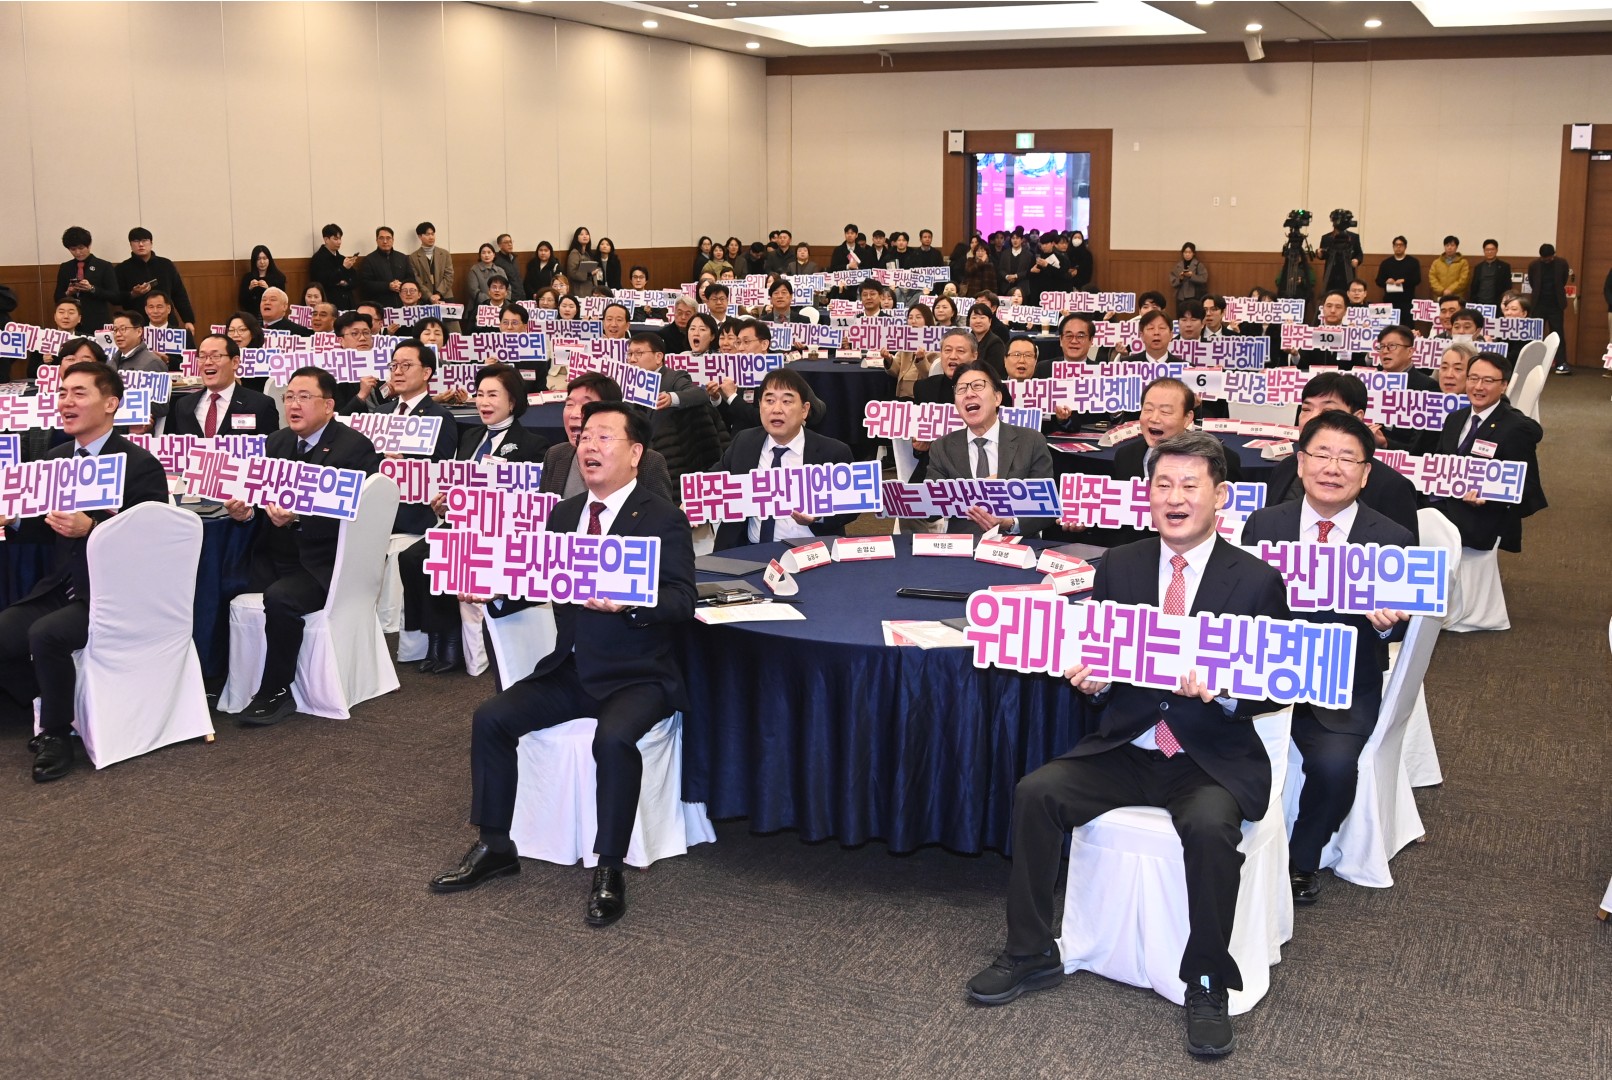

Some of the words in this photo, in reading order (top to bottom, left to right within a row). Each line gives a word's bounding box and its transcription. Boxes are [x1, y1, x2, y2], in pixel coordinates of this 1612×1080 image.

[667, 292, 677, 300] 16
[1040, 291, 1066, 311] 우리가
[1069, 292, 1095, 312] 살리는
[1097, 292, 1134, 313] 부산경제!
[446, 307, 457, 316] 12
[837, 318, 849, 327] 11
[1247, 301, 1303, 324] 부산상품으로!
[1375, 307, 1386, 315] 14
[1411, 300, 1437, 321] 구매는
[104, 335, 112, 344] 8
[849, 325, 882, 350] 우리가
[886, 326, 919, 351] 살리는
[1282, 325, 1313, 349] 발주는
[1319, 333, 1335, 343] 10
[1499, 318, 1542, 340] 부산경제!
[473, 333, 545, 361] 부산상품으로!
[1211, 340, 1264, 369] 부산경제!
[1196, 373, 1207, 386] 6
[1022, 379, 1068, 413] 살리는
[1073, 377, 1140, 412] 부산경제!
[864, 401, 912, 439] 우리가
[2, 455, 124, 517] 부산기업으로!
[185, 449, 240, 500] 구매는
[244, 456, 364, 519] 부산상품으로!
[682, 473, 743, 522] 발주는
[752, 462, 881, 518] 부산기업으로!
[1420, 454, 1526, 503] 부산상품으로!
[447, 487, 506, 538] 우리가
[926, 479, 1062, 518] 부산상품으로!
[1062, 475, 1122, 527] 발주는
[425, 531, 494, 595] 구매는
[503, 533, 658, 604] 부산상품으로!
[1261, 543, 1447, 613] 부산기업으로!
[966, 594, 1066, 674] 우리가
[1078, 603, 1181, 686] 살리는
[1195, 615, 1353, 706] 부산경제!
